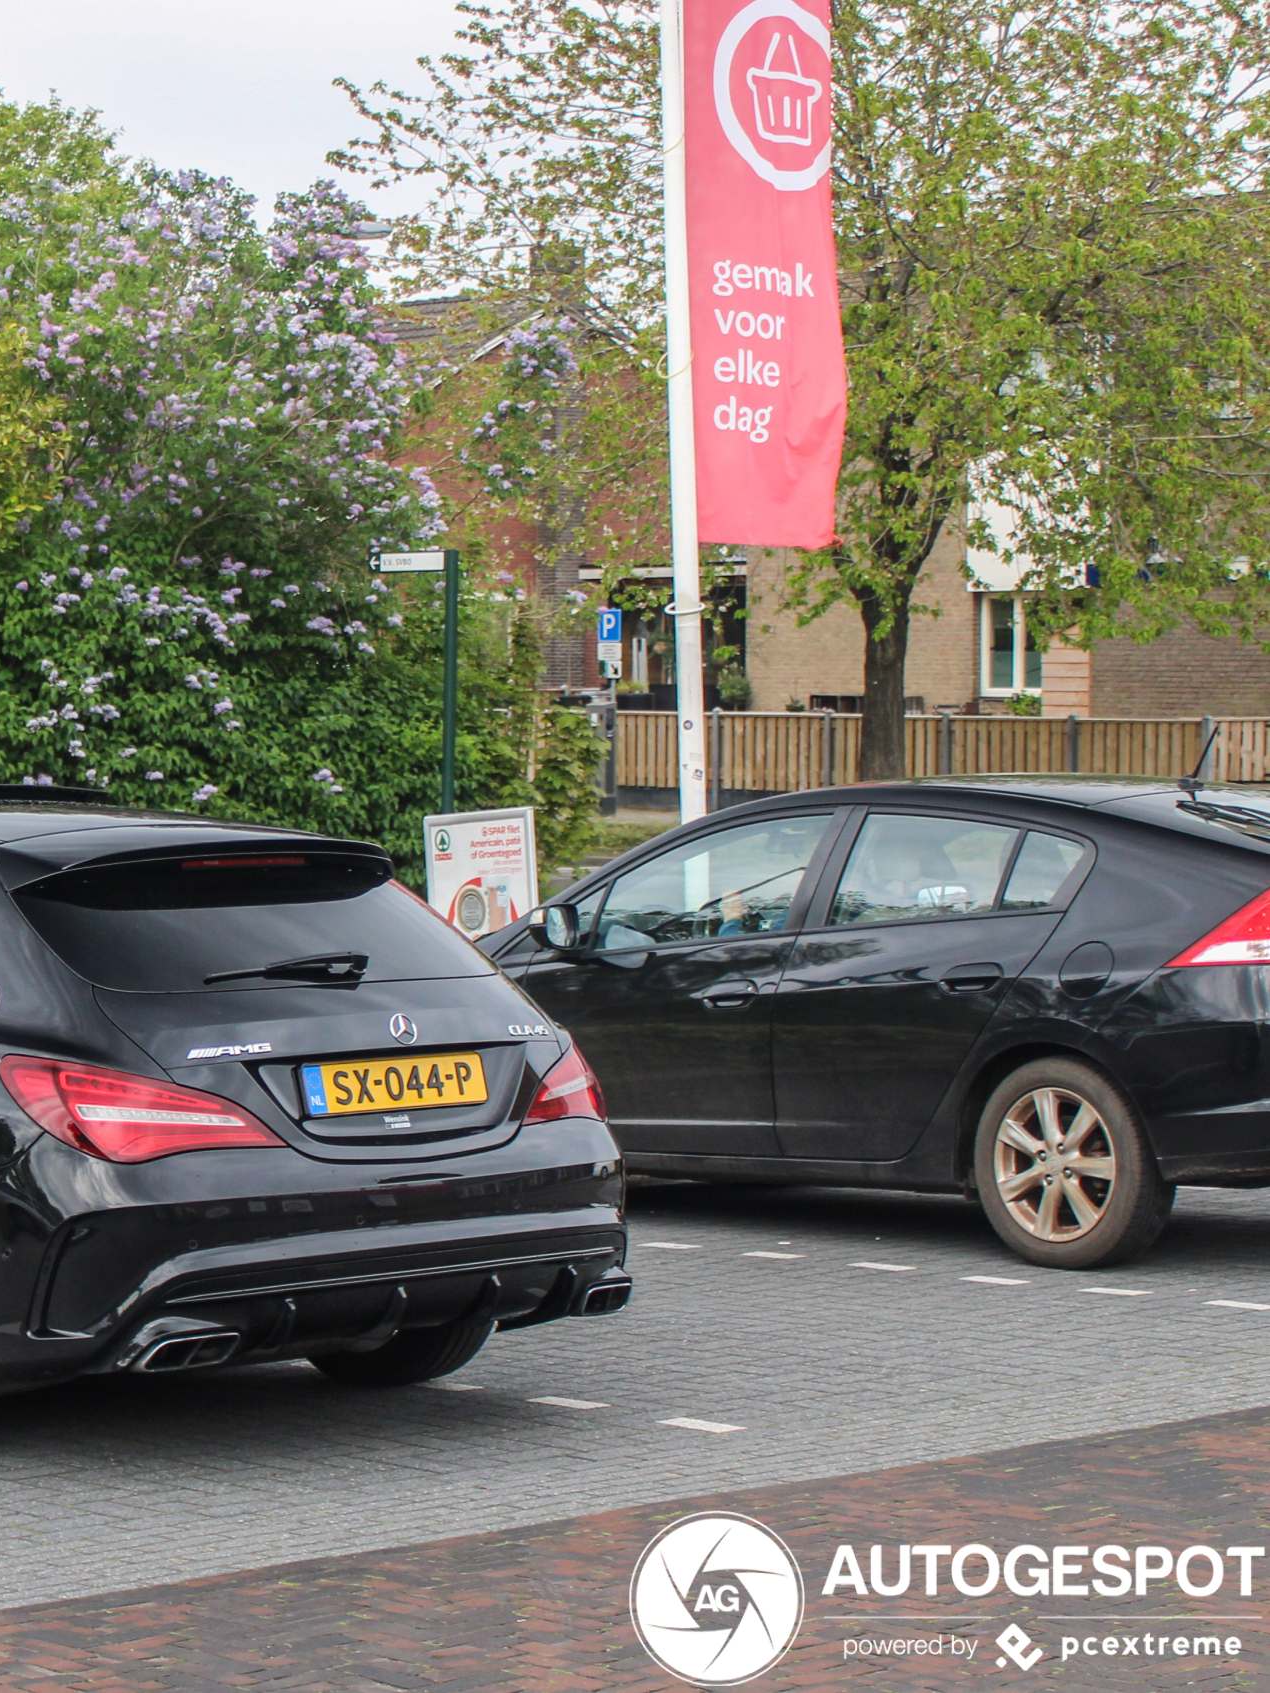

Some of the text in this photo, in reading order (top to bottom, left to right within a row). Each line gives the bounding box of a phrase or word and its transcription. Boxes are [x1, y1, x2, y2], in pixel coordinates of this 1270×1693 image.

[712, 259, 815, 297] gemak
[713, 308, 786, 340] voor
[713, 348, 781, 388] elke
[713, 395, 774, 444] dag
[602, 613, 616, 639] P
[488, 825, 520, 835] SPAR filet
[471, 848, 522, 859] of Groentegoed
[333, 1061, 472, 1106] SX-044-P
[310, 1095, 325, 1107] NL
[382, 1114, 411, 1124] Wensink
